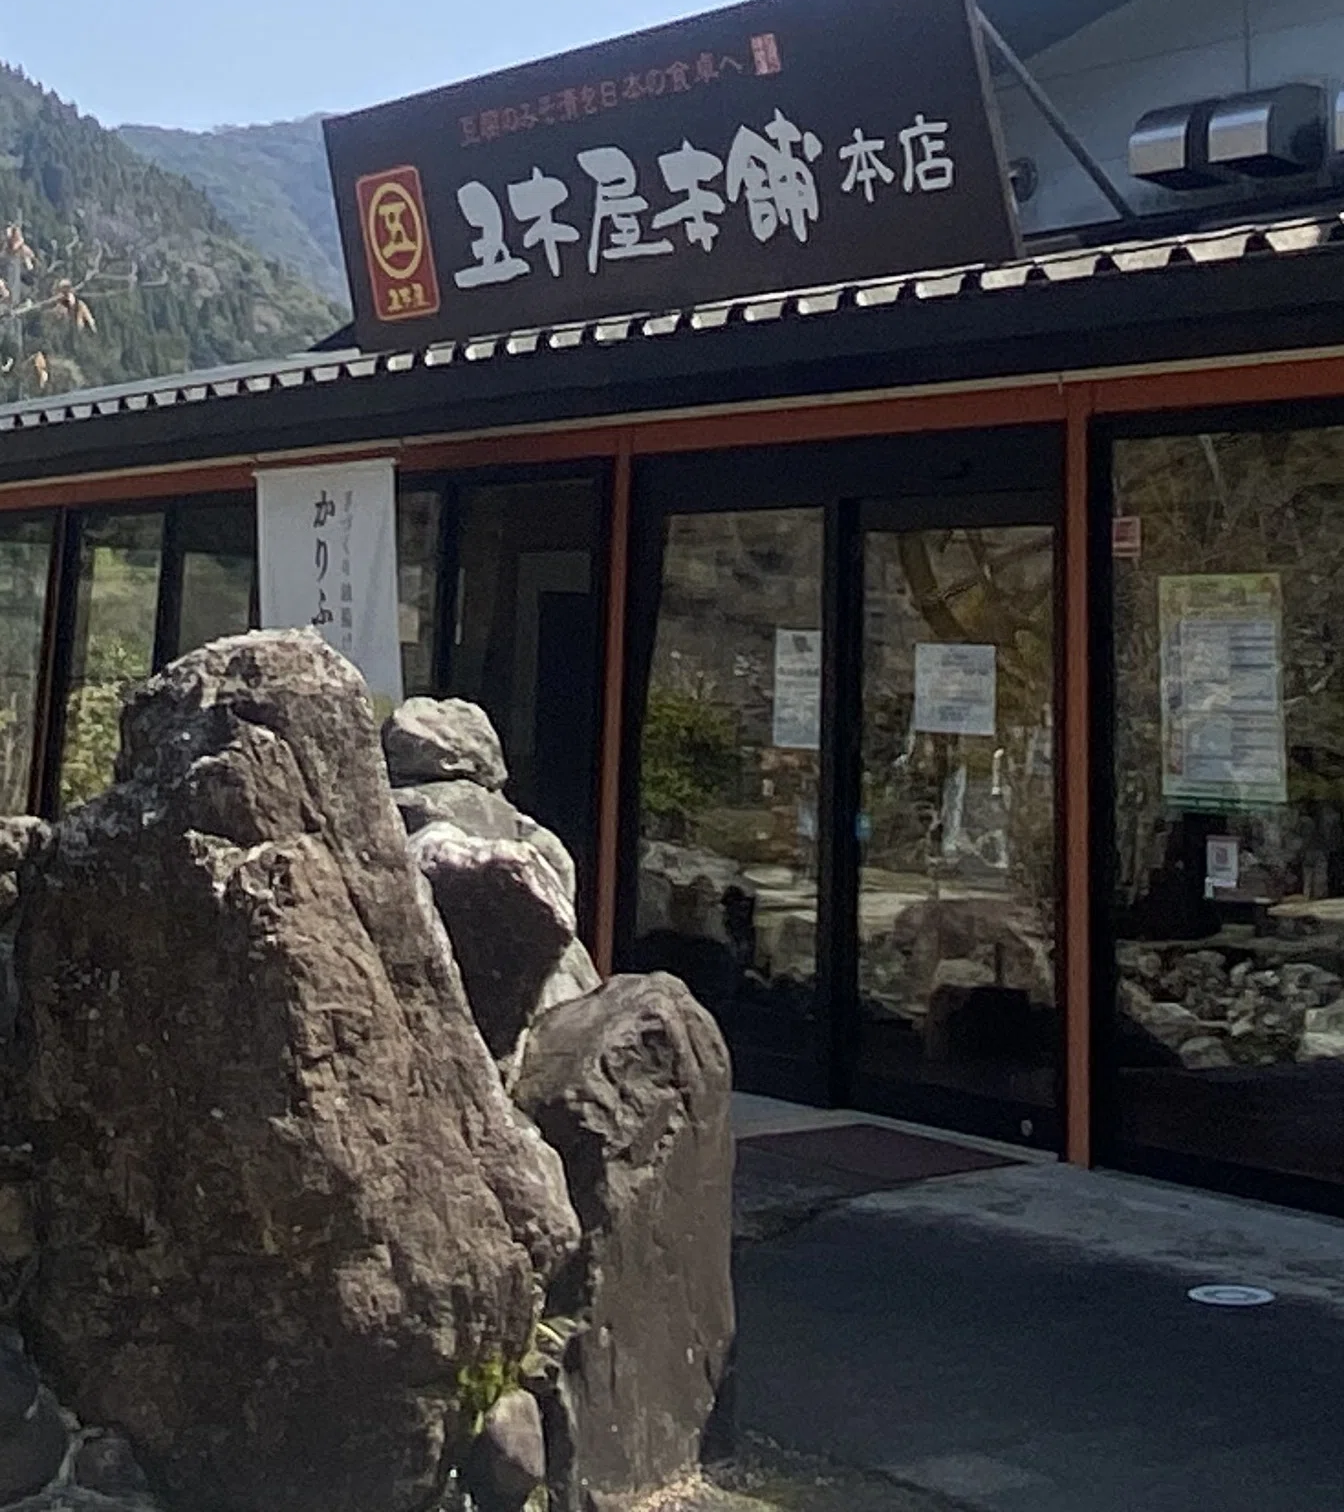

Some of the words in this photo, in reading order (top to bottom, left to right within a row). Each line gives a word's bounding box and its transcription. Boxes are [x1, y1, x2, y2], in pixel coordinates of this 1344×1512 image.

[455, 108, 823, 288] 五木屋本舗
[840, 114, 955, 204] 本店
